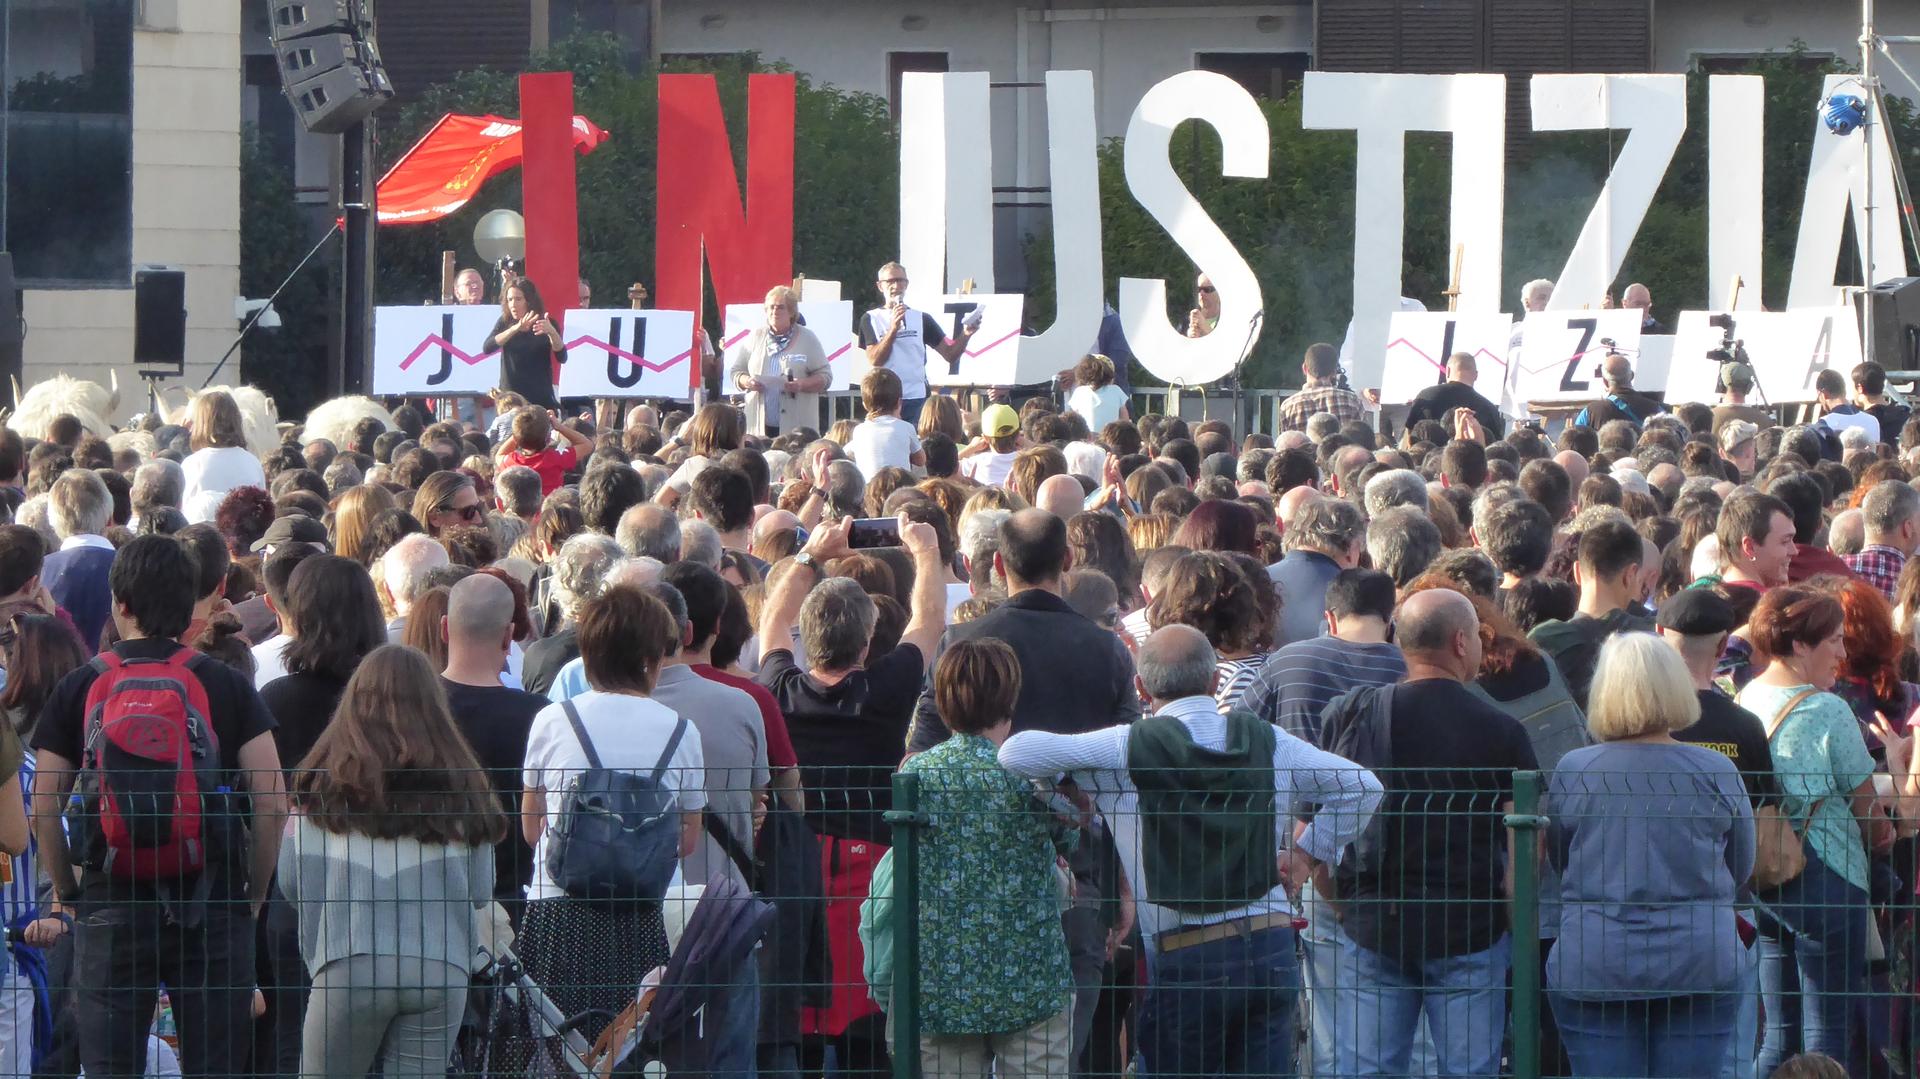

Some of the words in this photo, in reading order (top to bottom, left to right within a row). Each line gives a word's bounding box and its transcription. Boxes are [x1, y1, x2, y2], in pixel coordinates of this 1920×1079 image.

[426, 313, 454, 386] J
[607, 316, 648, 389] U
[943, 302, 979, 375] T
[1559, 318, 1598, 392] Z
[1802, 316, 1834, 390] A
